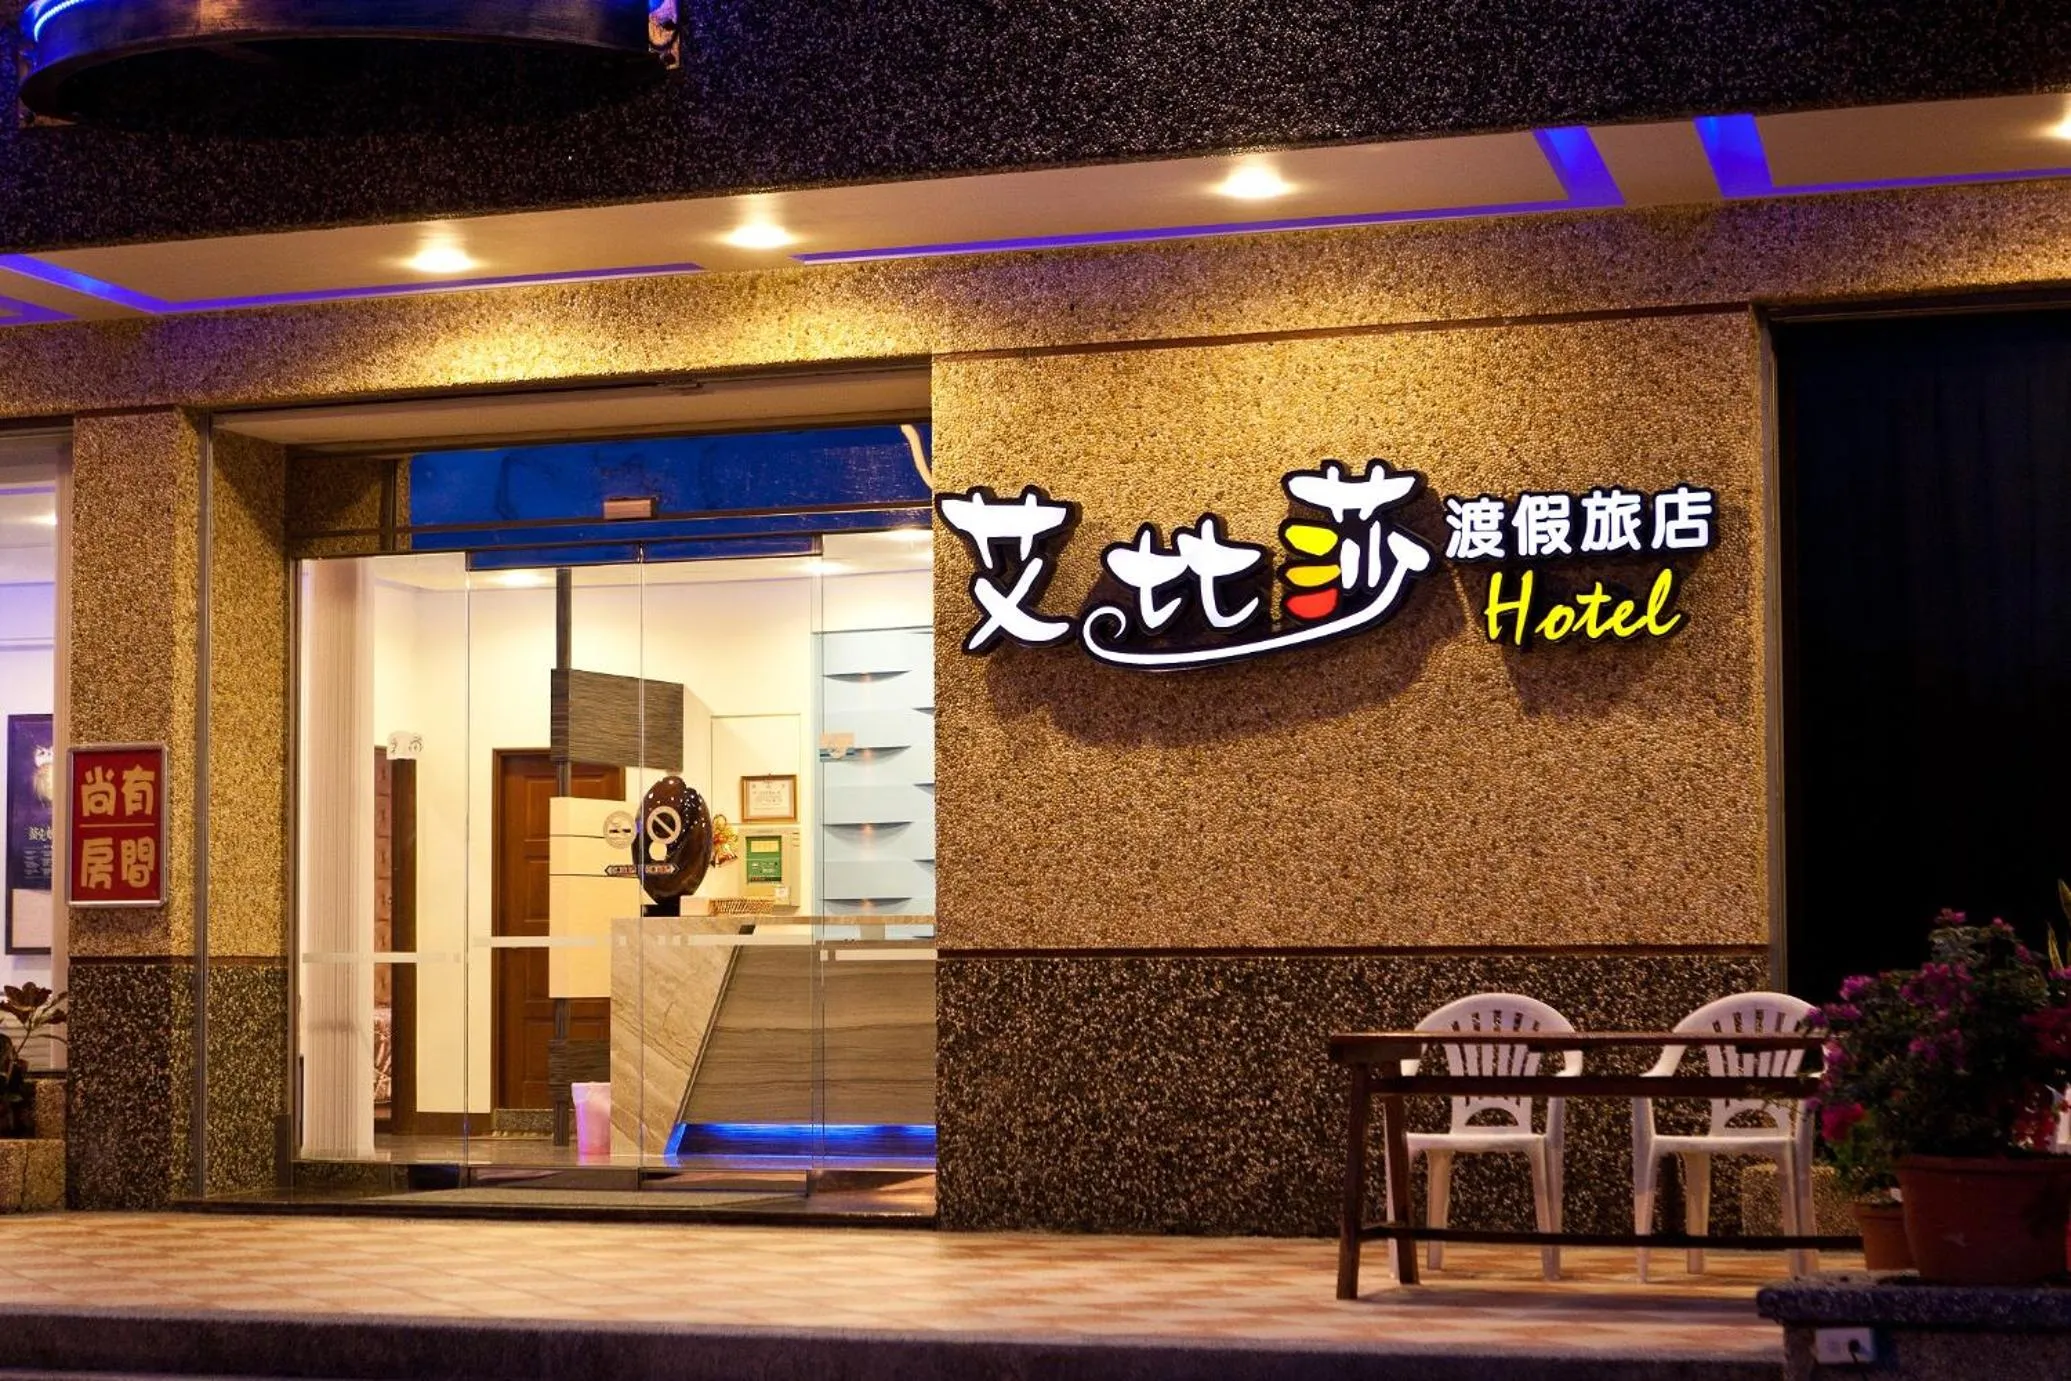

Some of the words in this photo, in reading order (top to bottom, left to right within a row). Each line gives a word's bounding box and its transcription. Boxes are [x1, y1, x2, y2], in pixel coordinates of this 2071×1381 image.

[1446, 487, 1712, 559] 渡假旅店
[942, 465, 1430, 664] 艾比莎
[1485, 568, 1681, 644] Hotel
[80, 765, 156, 817] 尚有
[80, 836, 156, 890] 房間
